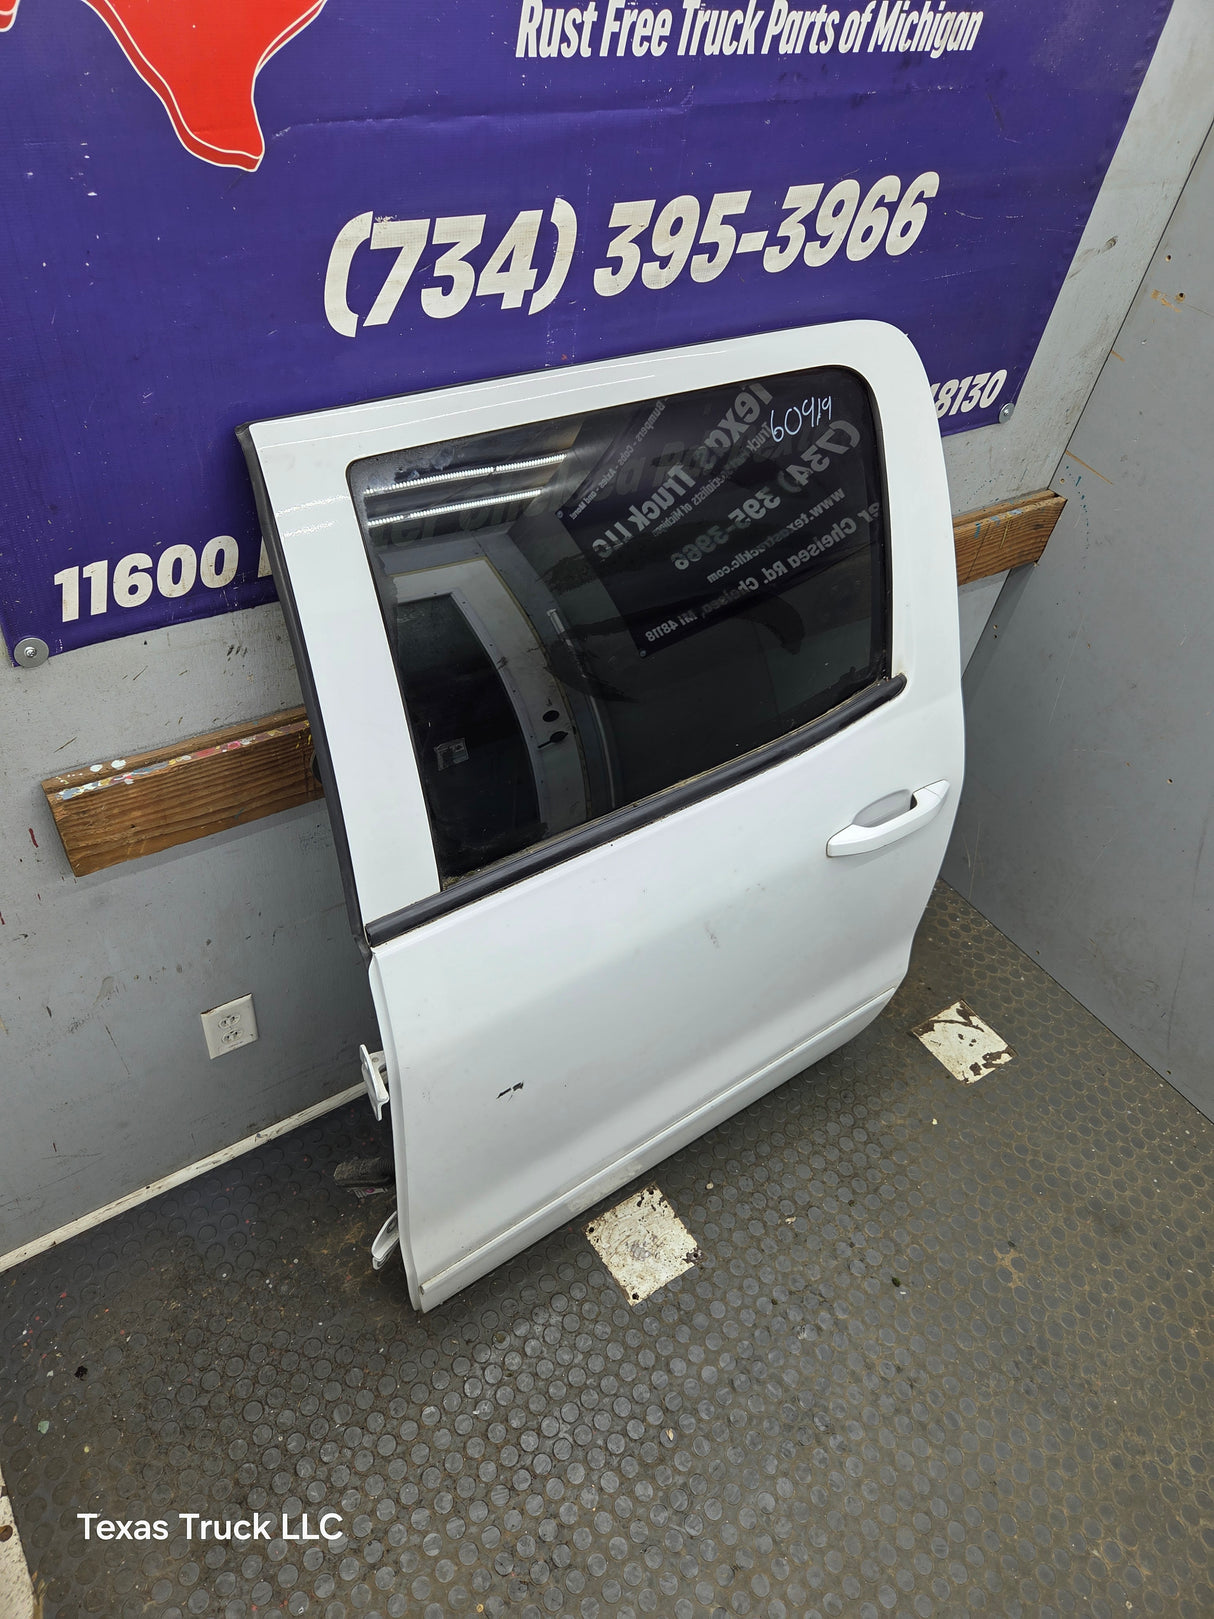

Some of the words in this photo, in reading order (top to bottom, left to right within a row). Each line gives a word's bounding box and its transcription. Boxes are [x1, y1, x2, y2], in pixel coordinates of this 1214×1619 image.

[515, 0, 598, 58] Rust
[598, 0, 673, 56] Free
[676, 0, 767, 55] Truck
[759, 0, 839, 55] Parts
[837, 0, 874, 55] of
[866, 0, 984, 59] Michigan
[323, 198, 577, 337] (734)
[591, 171, 940, 296] 395-3966
[53, 535, 240, 623] 11600
